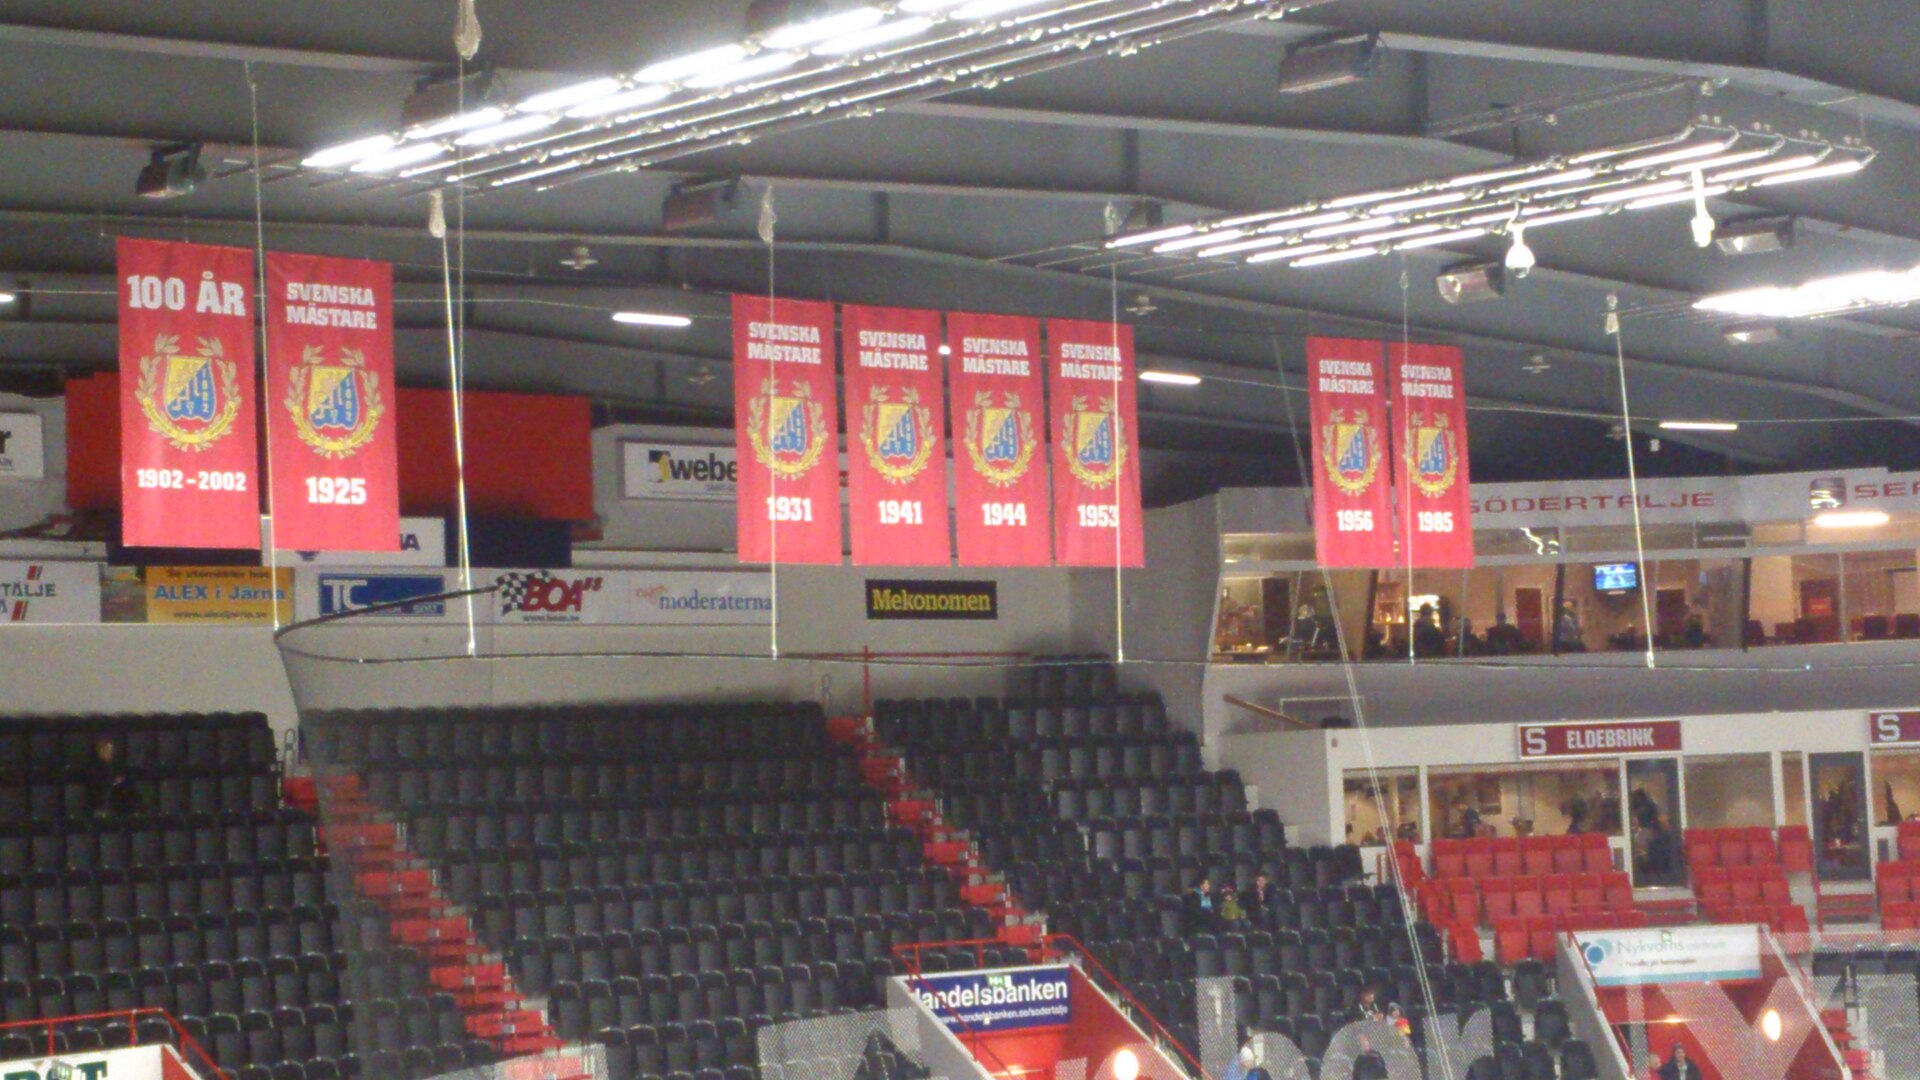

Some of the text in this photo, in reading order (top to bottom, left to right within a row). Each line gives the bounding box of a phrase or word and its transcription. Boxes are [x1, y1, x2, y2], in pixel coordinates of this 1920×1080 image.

[127, 271, 246, 317] 100 ÅR
[286, 282, 375, 306] SVENSKA
[286, 304, 377, 330] MÄSTARE
[749, 322, 820, 344] SVENSKA
[859, 331, 926, 350] SVENSKA
[748, 341, 821, 364] MÄSTARE
[962, 337, 1028, 356] SVENSKA
[1060, 343, 1122, 362] SVENSKA
[859, 348, 929, 371] MÄSTARE
[963, 355, 1030, 376] MÄSTARE
[1319, 360, 1372, 376] SVENSKA
[1060, 360, 1123, 382] MÄSTARE
[1401, 364, 1453, 381] SVENSKA
[1319, 376, 1375, 394] MÄSTARE
[1401, 380, 1454, 398] MÄSTARE
[305, 476, 367, 505] 1925
[766, 496, 813, 522] 1931
[877, 500, 923, 525] 1941
[1470, 492, 1716, 514] SÖDERTÄLJE
[981, 503, 1027, 527] 1944
[1077, 504, 1119, 528] 1953
[1337, 510, 1374, 532] 1956
[1418, 511, 1454, 533] 1985
[154, 585, 208, 601] ALEX
[228, 584, 286, 601] Järna
[659, 590, 772, 612] moderaterna
[872, 588, 992, 612] Mekonomen
[1566, 727, 1656, 750] ELDEBRINK
